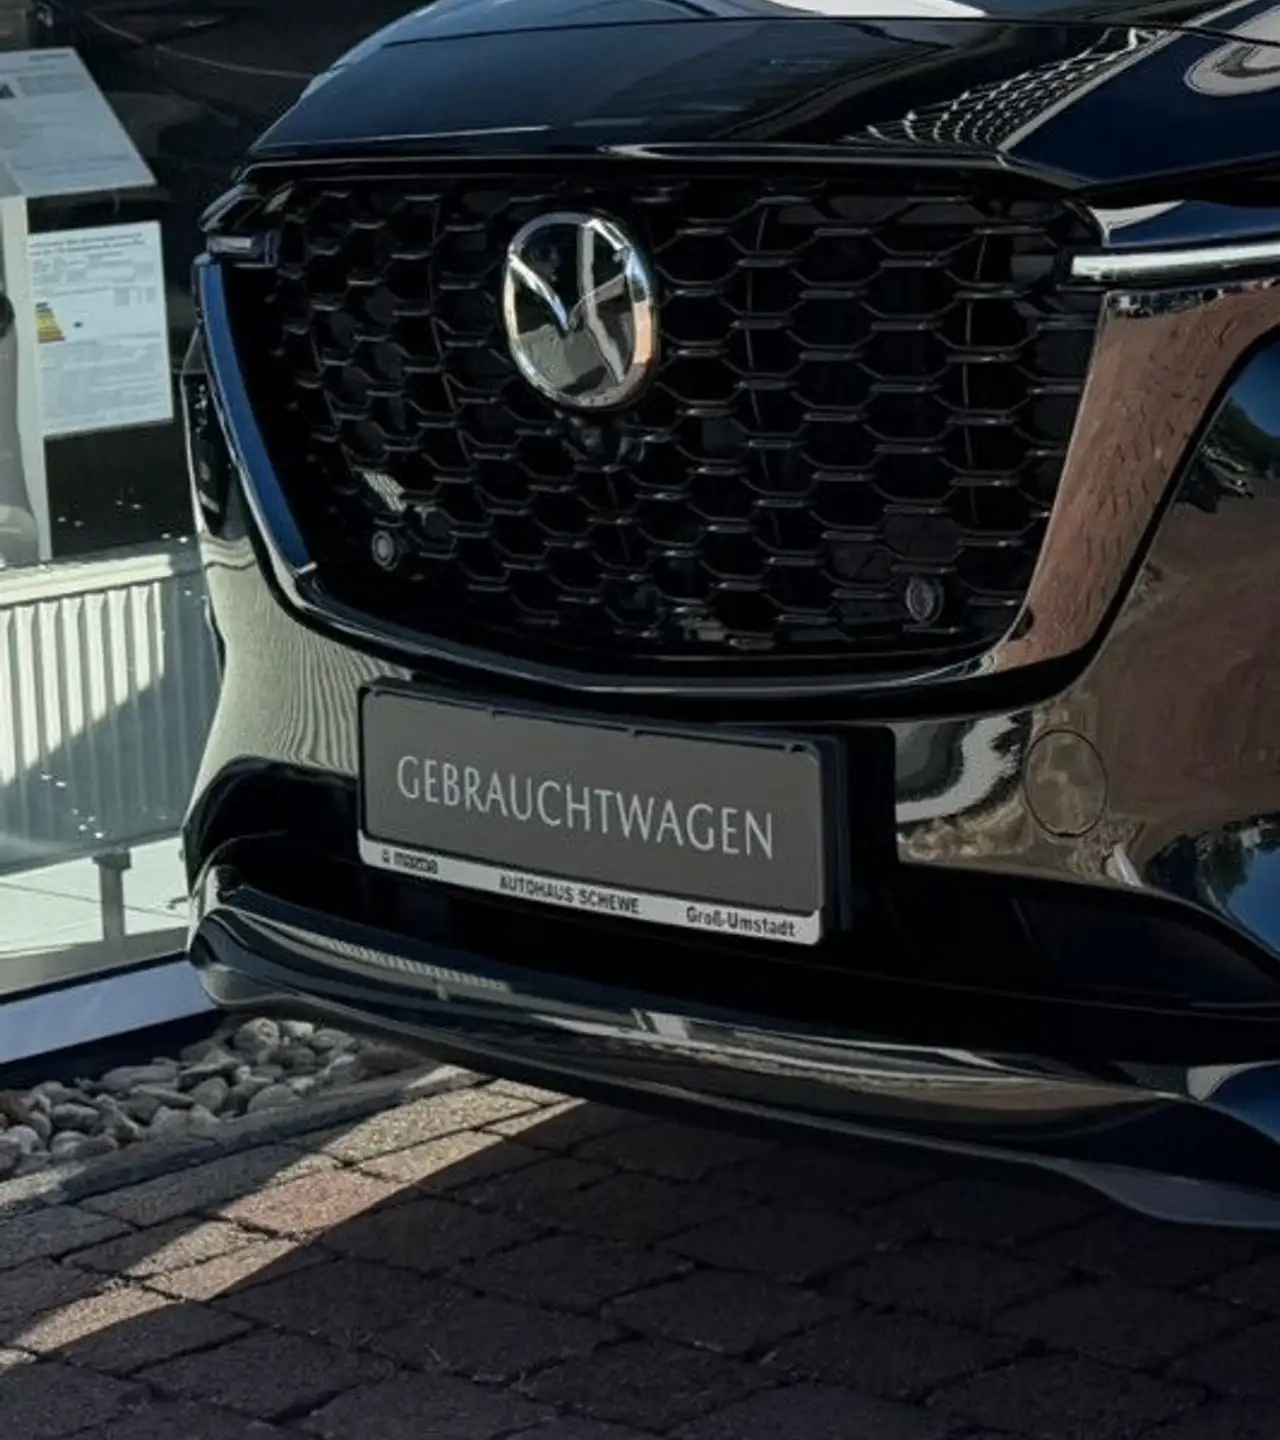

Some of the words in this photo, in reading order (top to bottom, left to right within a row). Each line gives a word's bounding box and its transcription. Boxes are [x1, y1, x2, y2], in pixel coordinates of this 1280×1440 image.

[397, 755, 775, 860] GEBRAUCHTWAGEN
[499, 874, 575, 904] AUTOHAUS
[578, 890, 641, 914] SCHEWE
[686, 905, 796, 937] Groß-Umstadt
